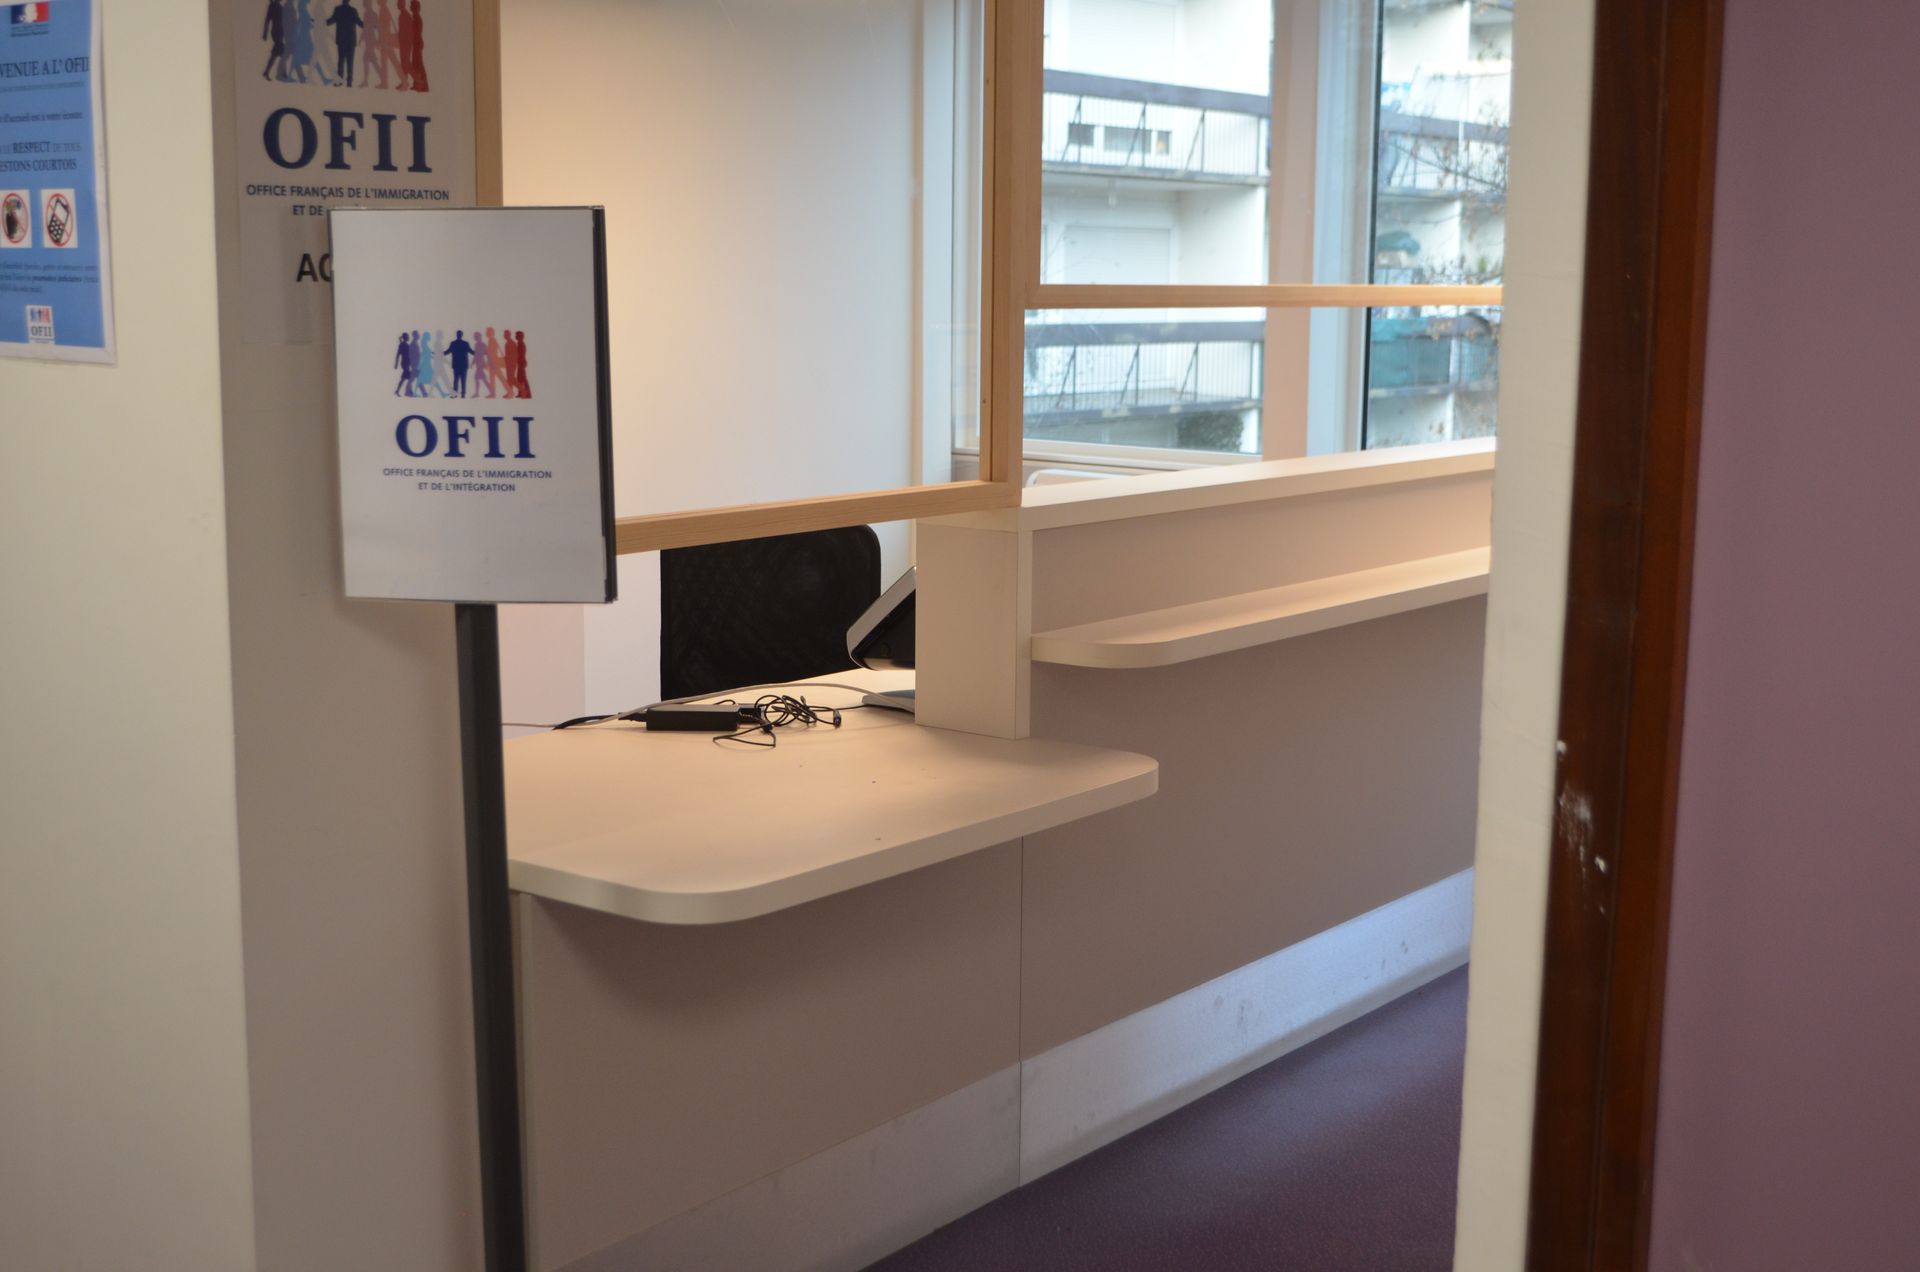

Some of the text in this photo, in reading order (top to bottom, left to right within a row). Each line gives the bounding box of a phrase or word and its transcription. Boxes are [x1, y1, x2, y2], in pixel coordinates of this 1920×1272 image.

[263, 107, 433, 173] OFII
[13, 141, 50, 154] RESPECT
[33, 158, 77, 171] COURTOIS
[246, 184, 449, 200] OFFICE FRANÇAIS DE L'IMMIGRATION
[292, 205, 323, 216] ET DE
[31, 325, 52, 337] OFII
[395, 414, 536, 458] OFII
[383, 468, 552, 479] OFFICE FRANÇAIS DE L'IMMIGRATION
[418, 480, 516, 492] ET DE L'INTÉGRATION
